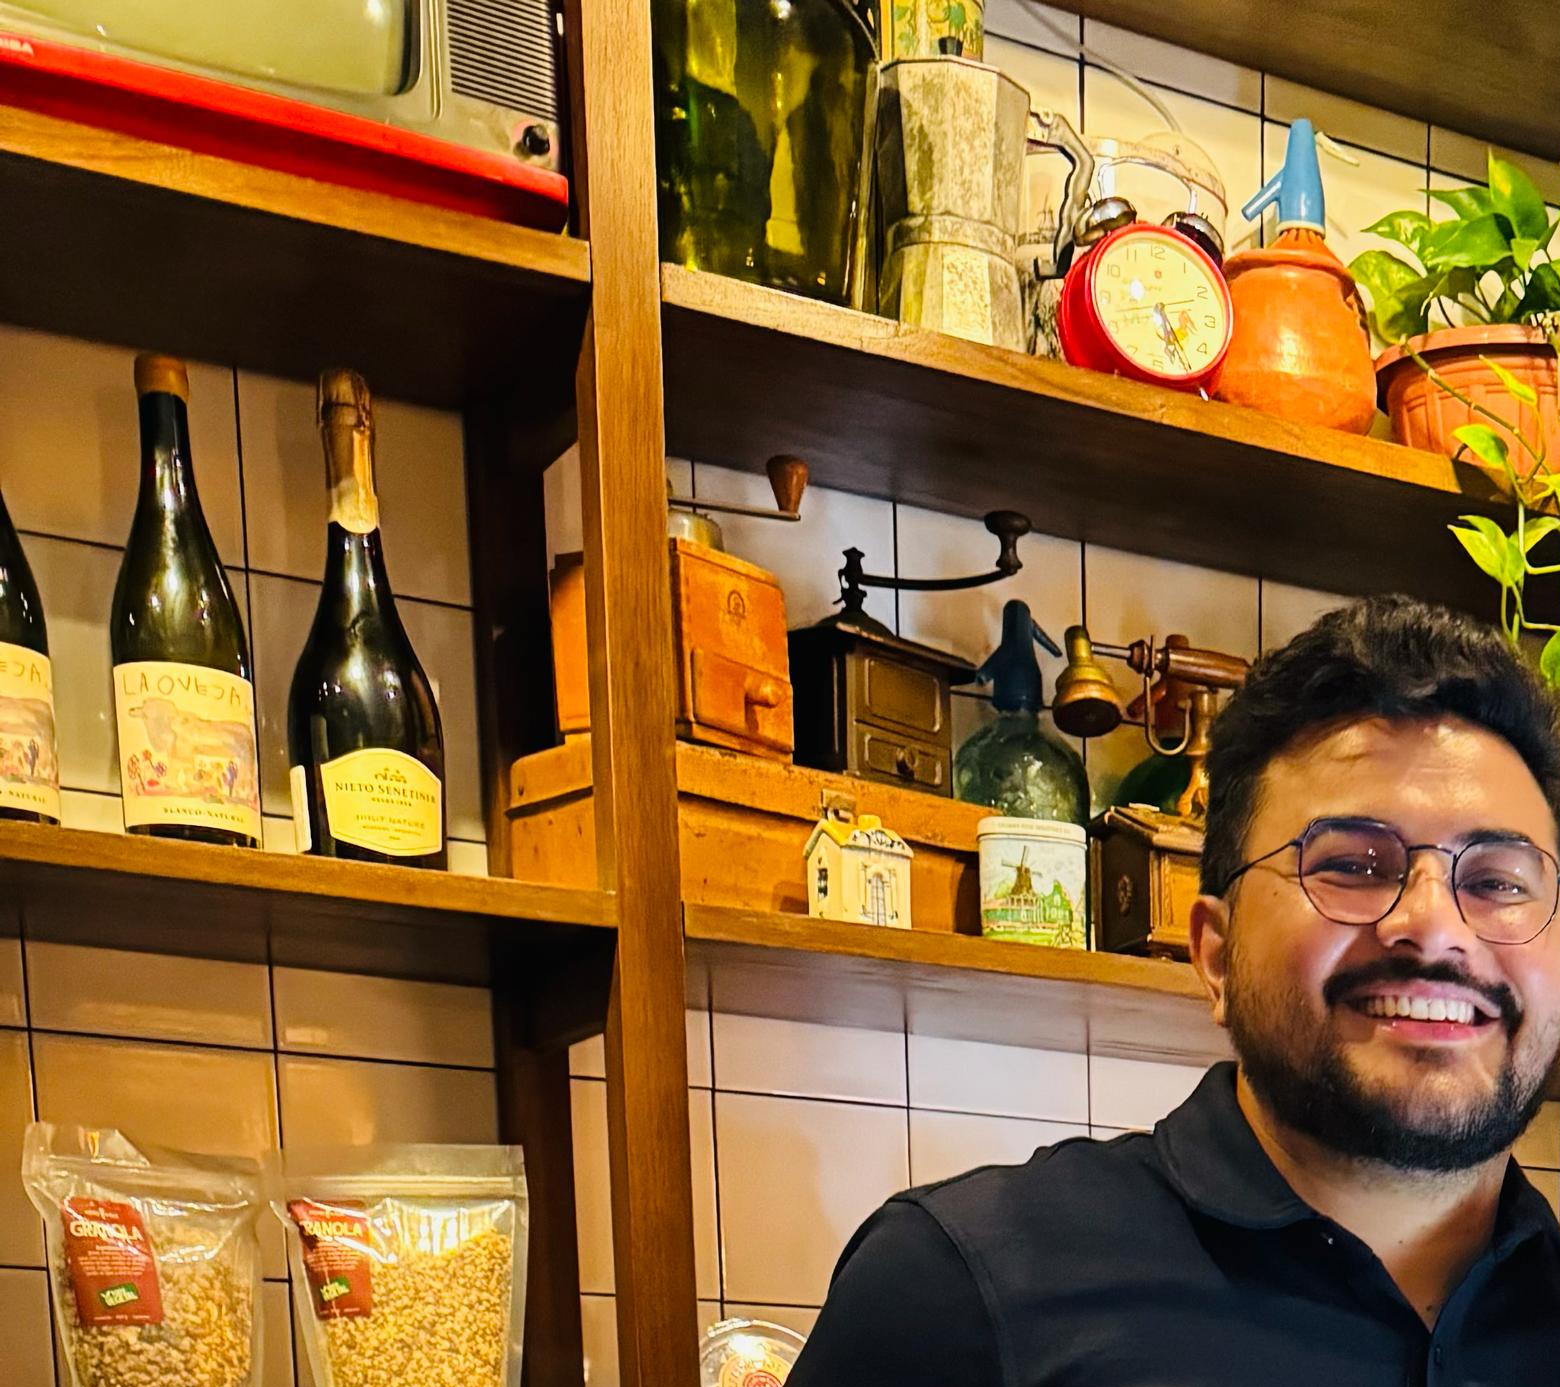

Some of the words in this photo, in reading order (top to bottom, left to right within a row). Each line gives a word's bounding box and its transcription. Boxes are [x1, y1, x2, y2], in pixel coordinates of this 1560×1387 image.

[1126, 247, 1137, 262] 11
[1150, 245, 1166, 260] 12
[1106, 263, 1121, 278] 10
[1196, 286, 1209, 300] 2
[1204, 315, 1216, 329] 3
[1196, 342, 1208, 355] 4
[69, 1220, 144, 1245] GRANOLA
[299, 1220, 363, 1237] RANOLA
